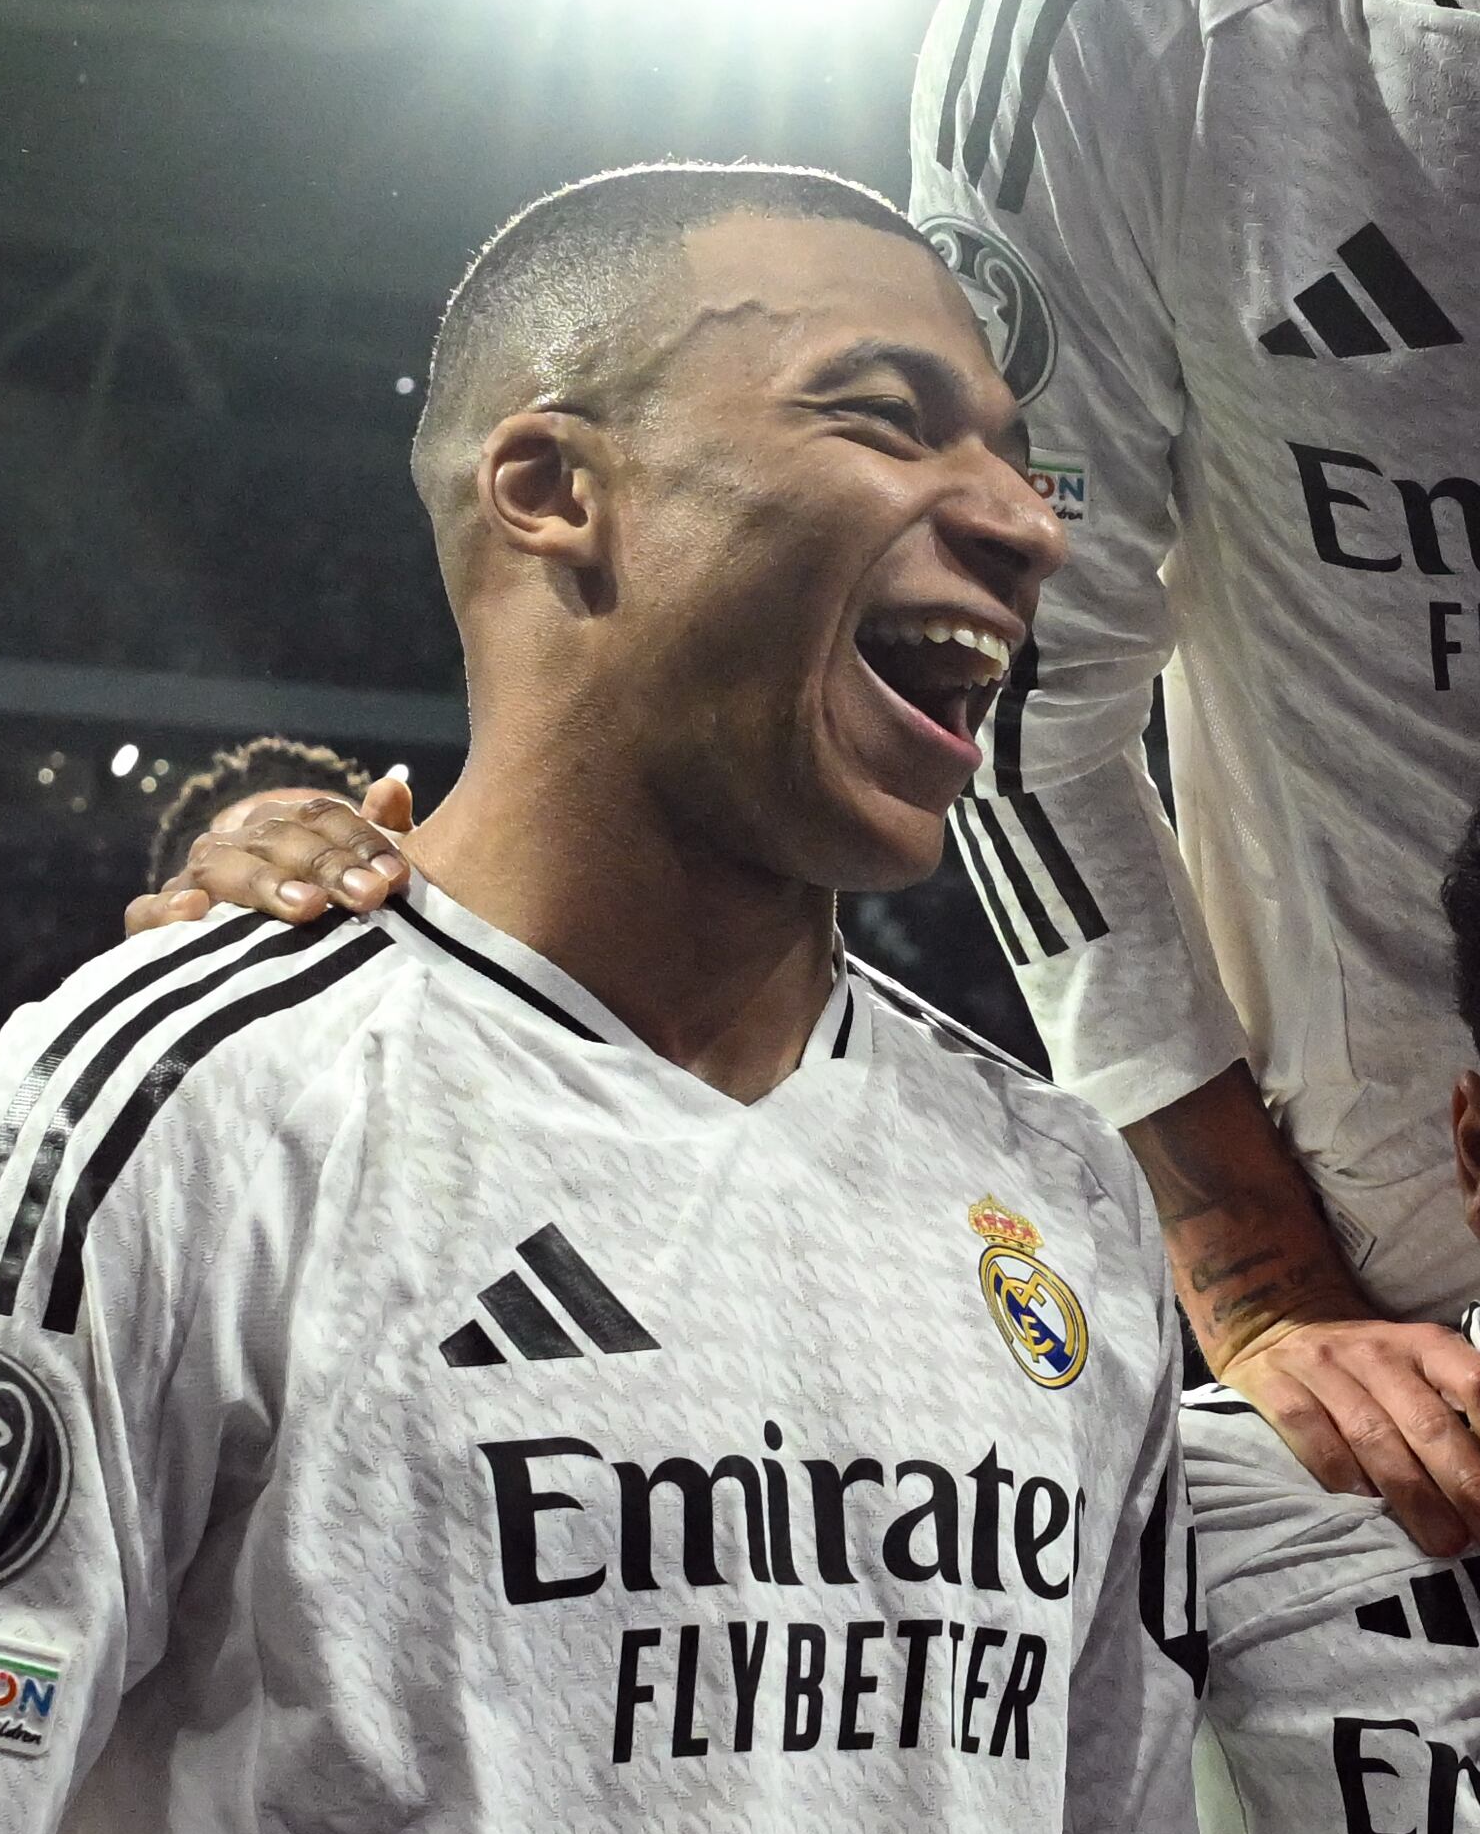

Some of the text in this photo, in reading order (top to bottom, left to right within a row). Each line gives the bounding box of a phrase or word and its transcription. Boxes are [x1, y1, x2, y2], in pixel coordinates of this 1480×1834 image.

[476, 1419, 1086, 1605] Emirate
[612, 1618, 1048, 1764] FLY BETTER
